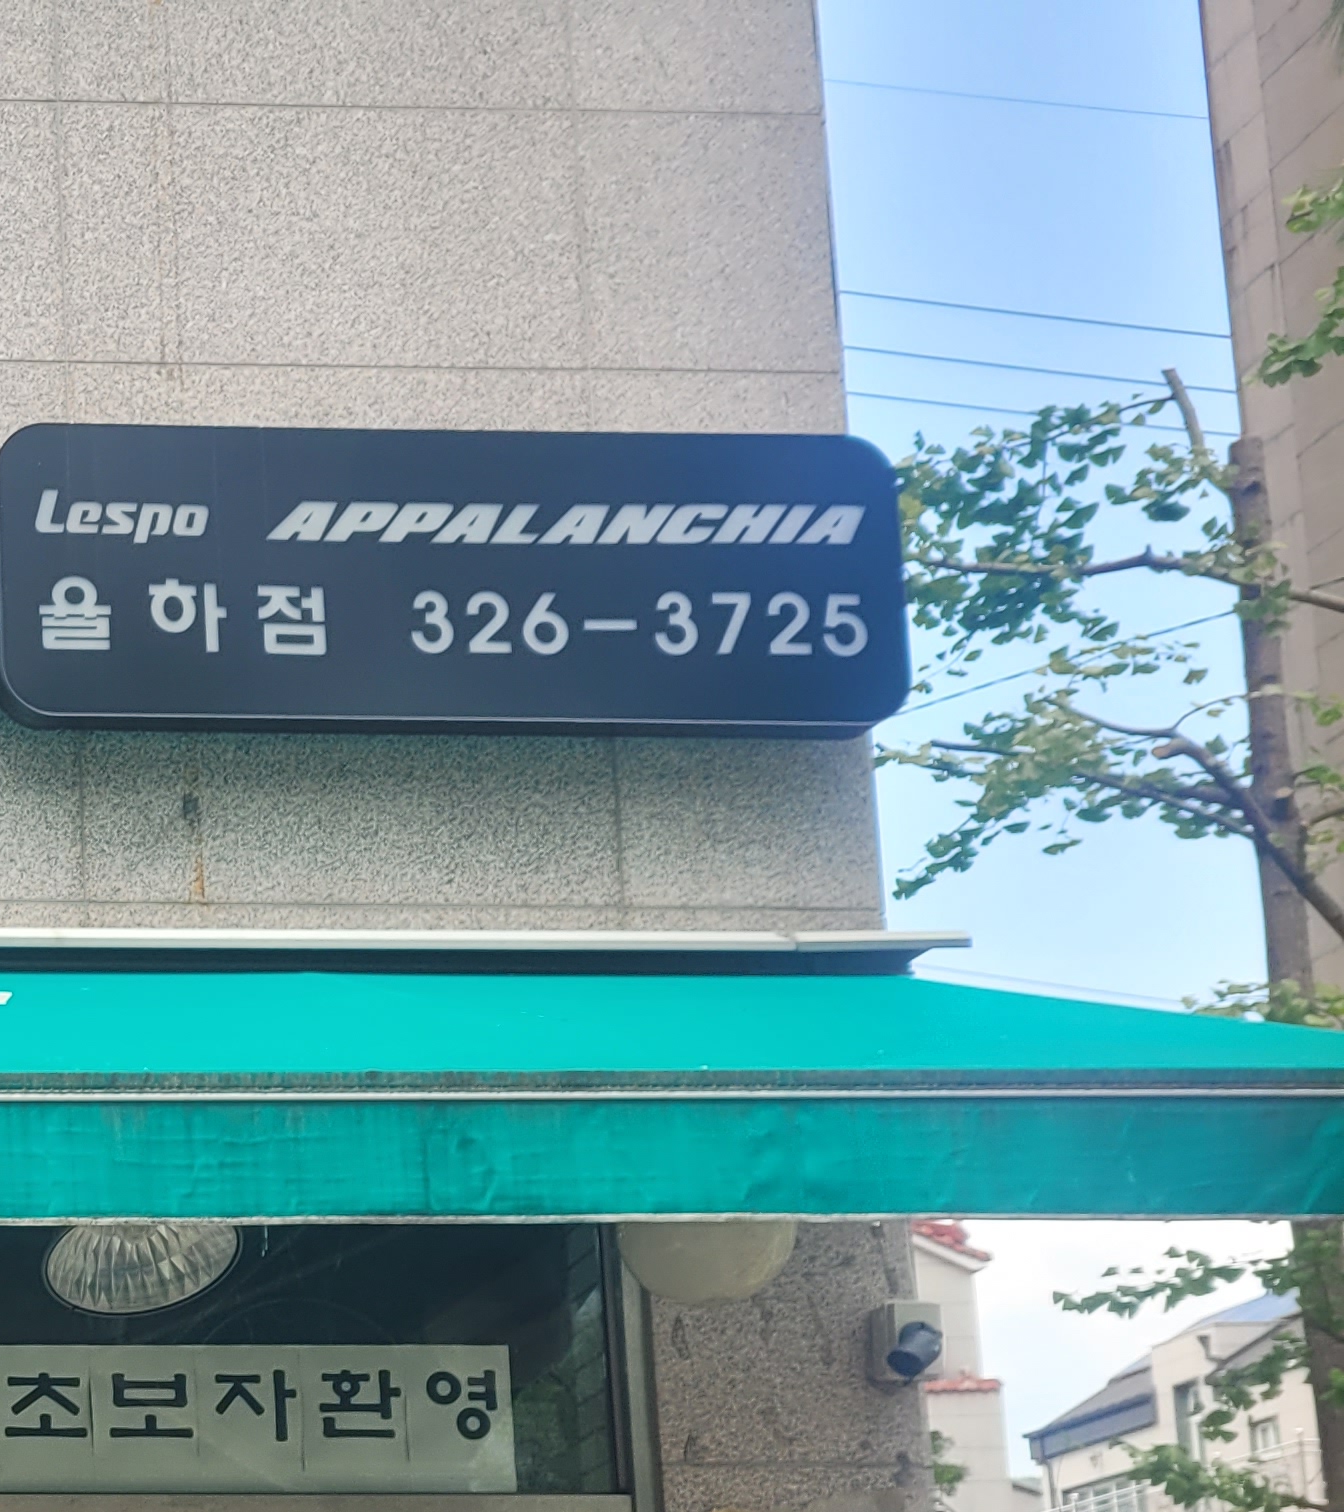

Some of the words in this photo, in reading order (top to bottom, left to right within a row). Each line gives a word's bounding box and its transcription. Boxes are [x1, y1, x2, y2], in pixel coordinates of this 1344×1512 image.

[34, 489, 210, 544] Lespo
[266, 500, 866, 546] APPALANCHIA
[39, 576, 327, 657] 율하점
[410, 590, 869, 658] 326-3725
